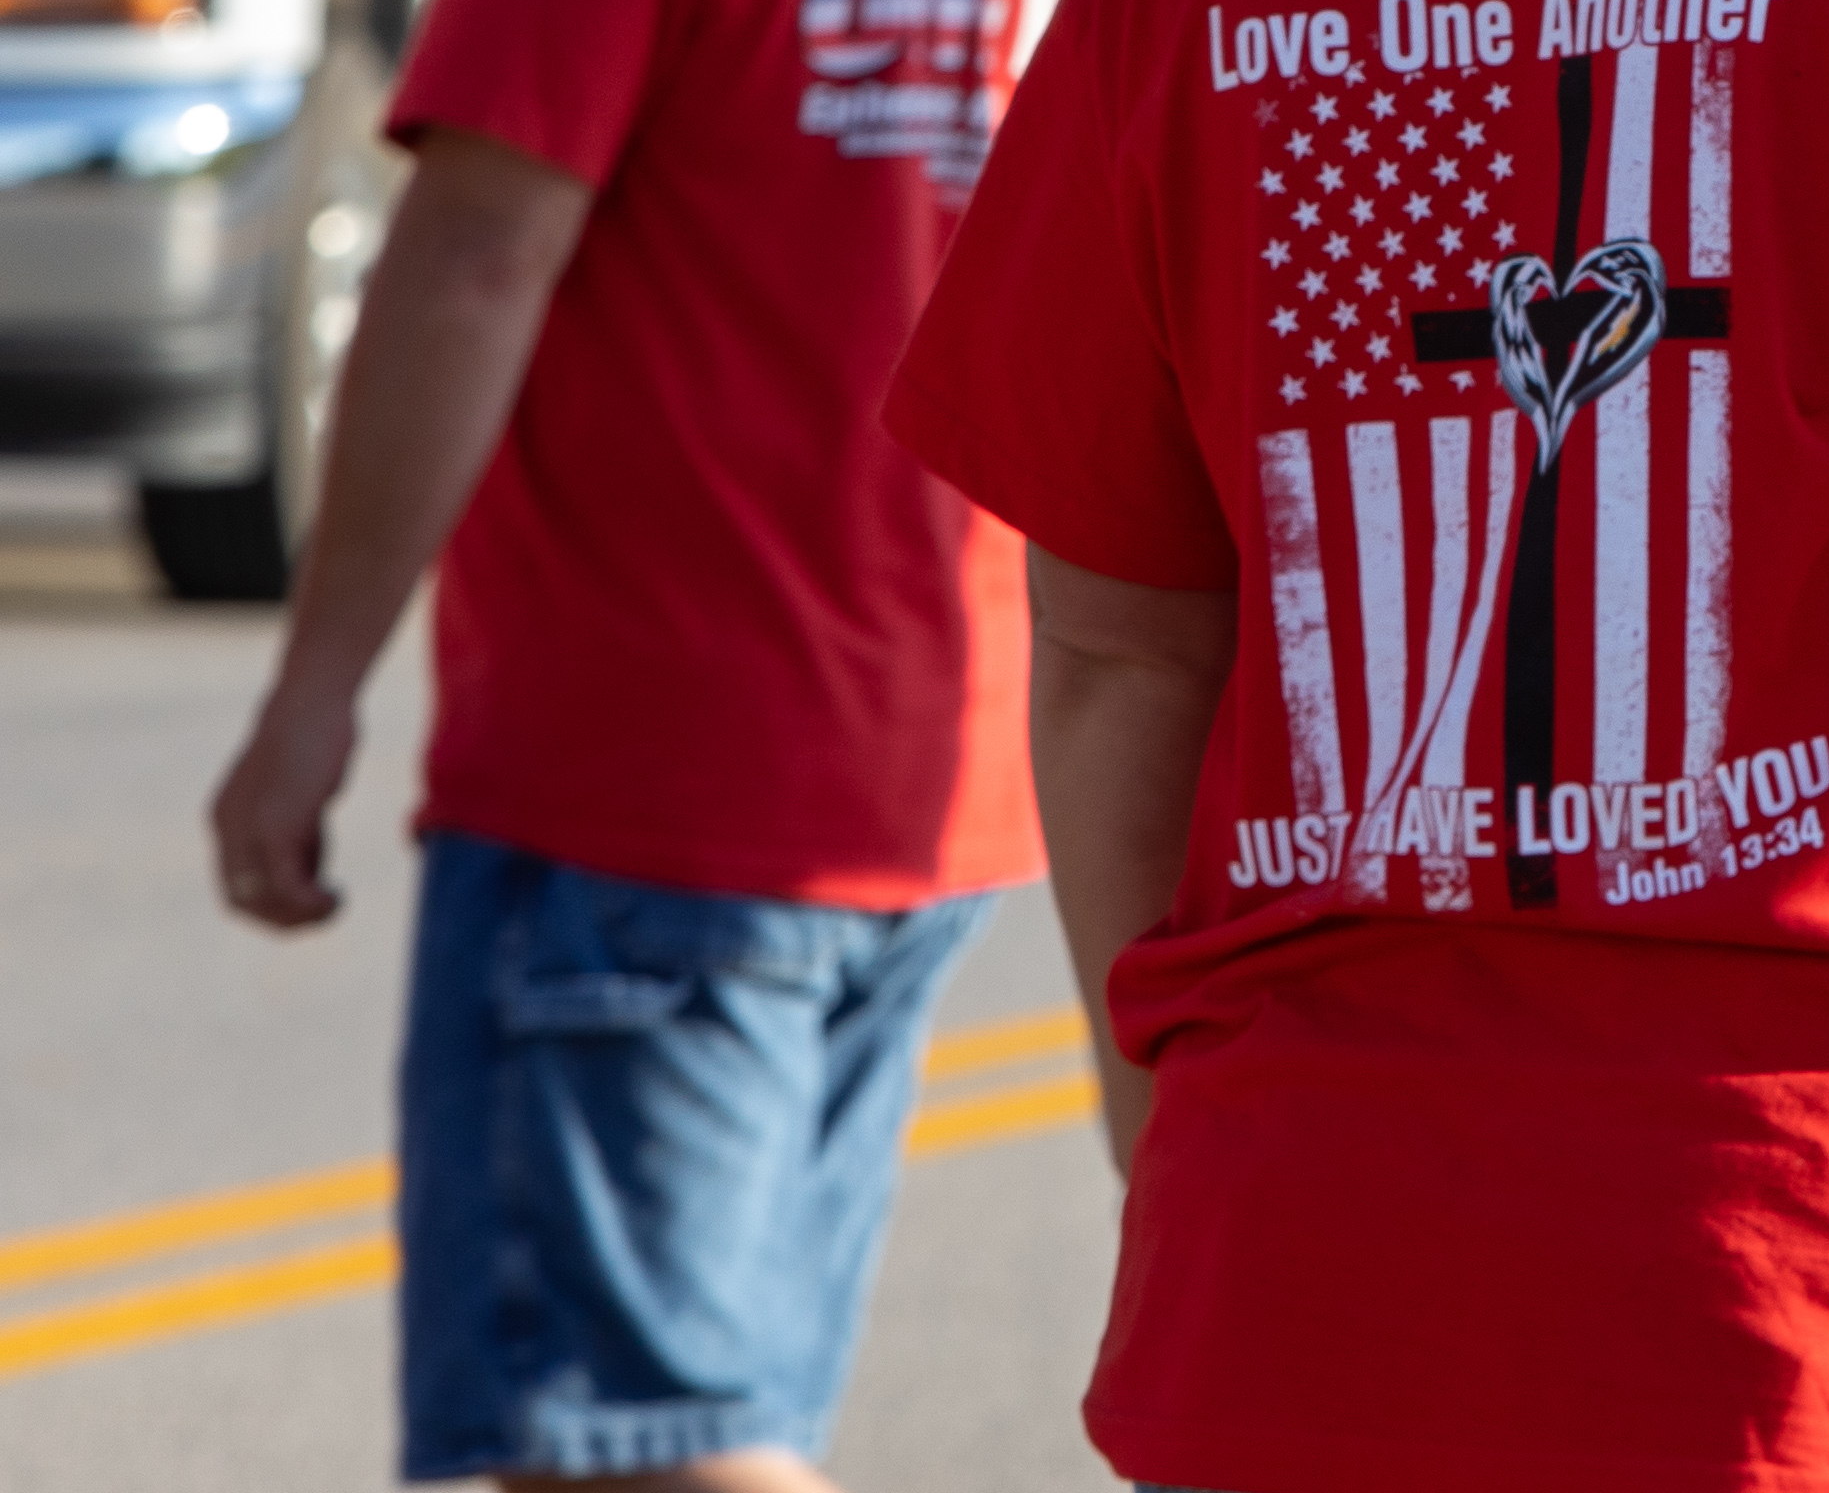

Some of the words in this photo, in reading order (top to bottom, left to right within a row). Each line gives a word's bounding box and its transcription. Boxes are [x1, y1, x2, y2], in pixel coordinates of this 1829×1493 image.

[1208, 5, 1350, 92] Love
[1227, 811, 1352, 889] JUST
[1516, 777, 1698, 858] LOVED
[1604, 857, 1703, 907] John
[1718, 805, 1825, 879] 13:34
